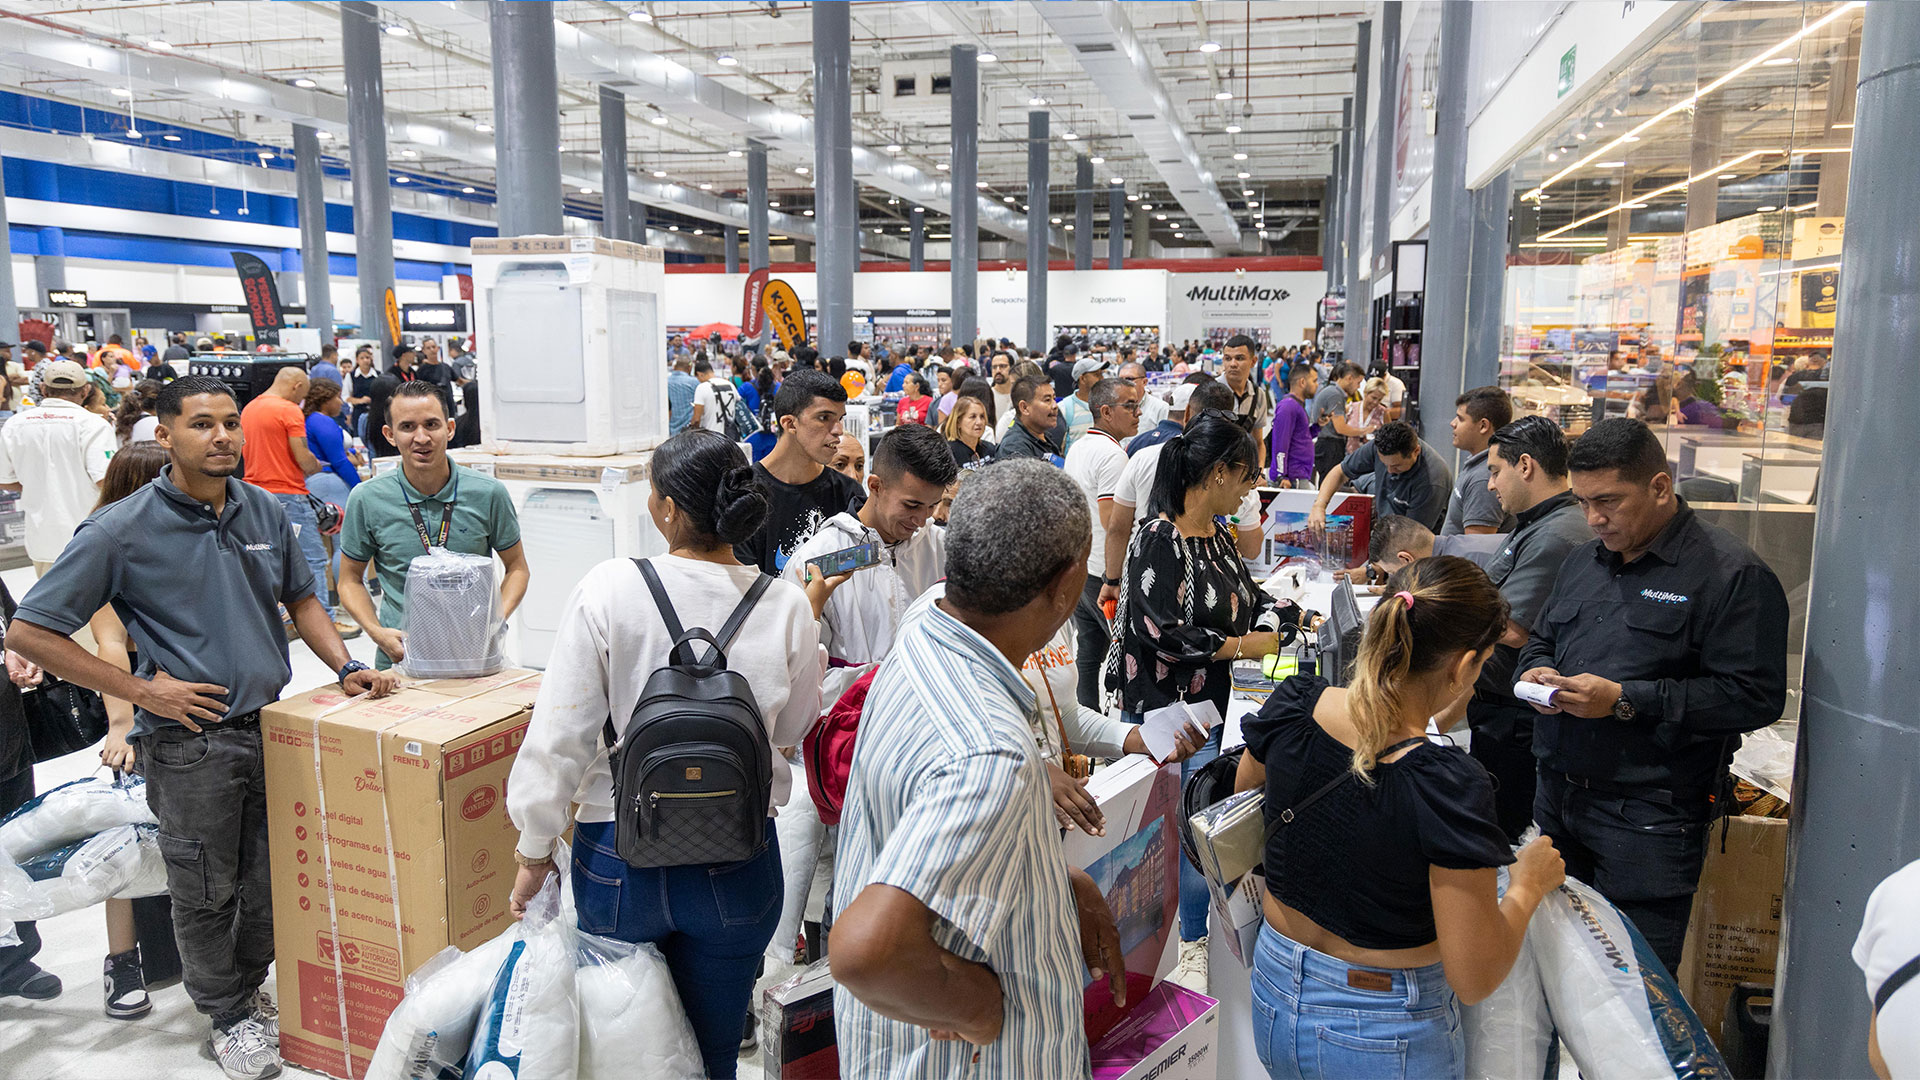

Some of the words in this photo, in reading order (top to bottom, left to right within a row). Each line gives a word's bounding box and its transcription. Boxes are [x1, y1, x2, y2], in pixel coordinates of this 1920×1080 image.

[244, 278, 265, 326] PROMOS
[257, 277, 277, 326] CONDESA
[1190, 285, 1283, 301] MultiMax
[749, 281, 760, 332] CONDESA
[1641, 588, 1684, 602] MultiMax
[393, 755, 421, 768] FRENTE
[463, 796, 494, 815] CONDESA
[314, 807, 337, 820] Pnel
[338, 813, 363, 826] digital
[327, 833, 371, 852] Programas
[351, 912, 374, 923] acero
[323, 975, 335, 985] KIT
